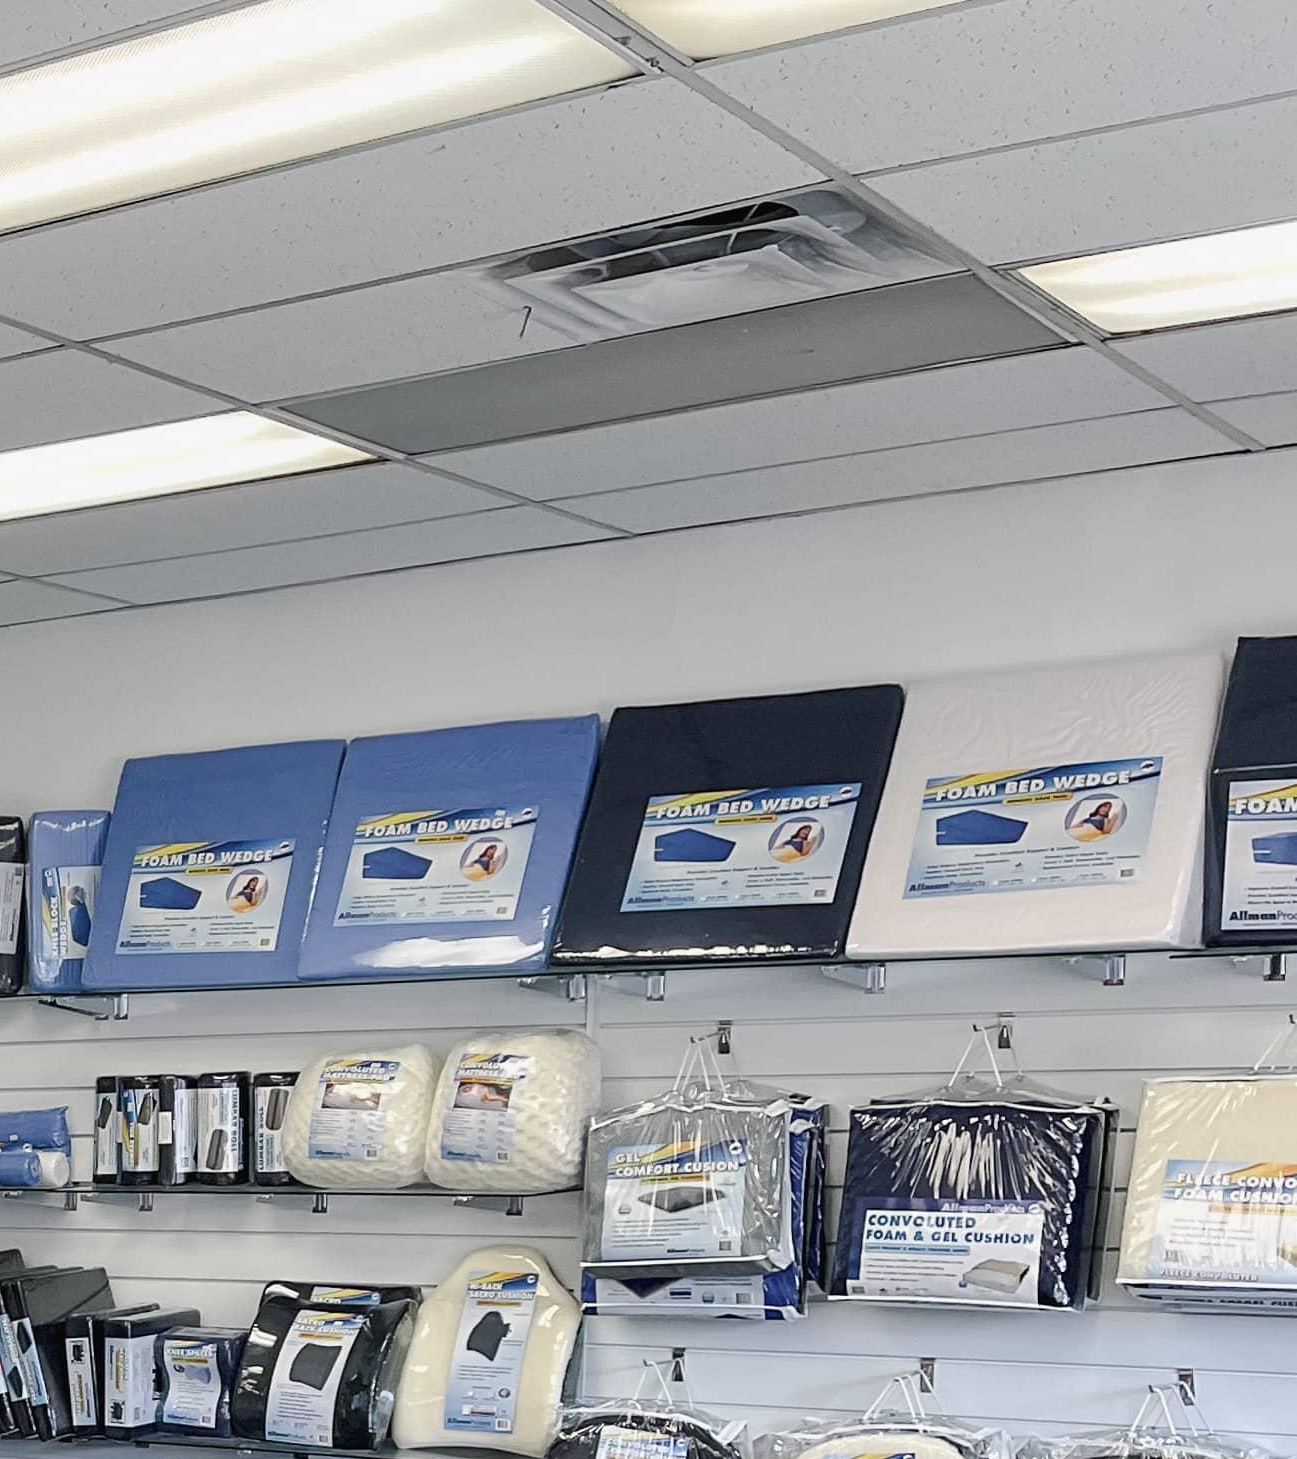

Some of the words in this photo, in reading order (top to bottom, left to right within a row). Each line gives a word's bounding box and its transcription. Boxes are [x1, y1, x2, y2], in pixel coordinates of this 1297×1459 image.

[935, 782, 997, 802] FOAM
[1005, 778, 1045, 794] BED
[1053, 770, 1131, 790] WEDGE
[656, 804, 710, 820] FOAM
[717, 801, 753, 815] BED
[760, 795, 831, 811] WEDGE
[365, 824, 411, 838] FOAM
[416, 821, 448, 835] BED
[454, 817, 513, 832] WEDGE
[141, 855, 183, 868] FOAM
[188, 853, 215, 865] BED
[220, 849, 273, 864] WEDGE
[50, 896, 59, 927] BLOCK
[615, 1152, 641, 1164] GEL
[615, 1162, 680, 1177] COMFORT
[683, 1160, 739, 1173] CUSION
[1174, 1188, 1223, 1200] FOAM
[868, 1214, 976, 1229] CONVOLUTED
[866, 1230, 907, 1241] FOAM
[913, 1231, 923, 1241] &
[931, 1231, 958, 1243] GEL
[964, 1232, 1035, 1244] CUSHION
[468, 1290, 499, 1299] SACRO
